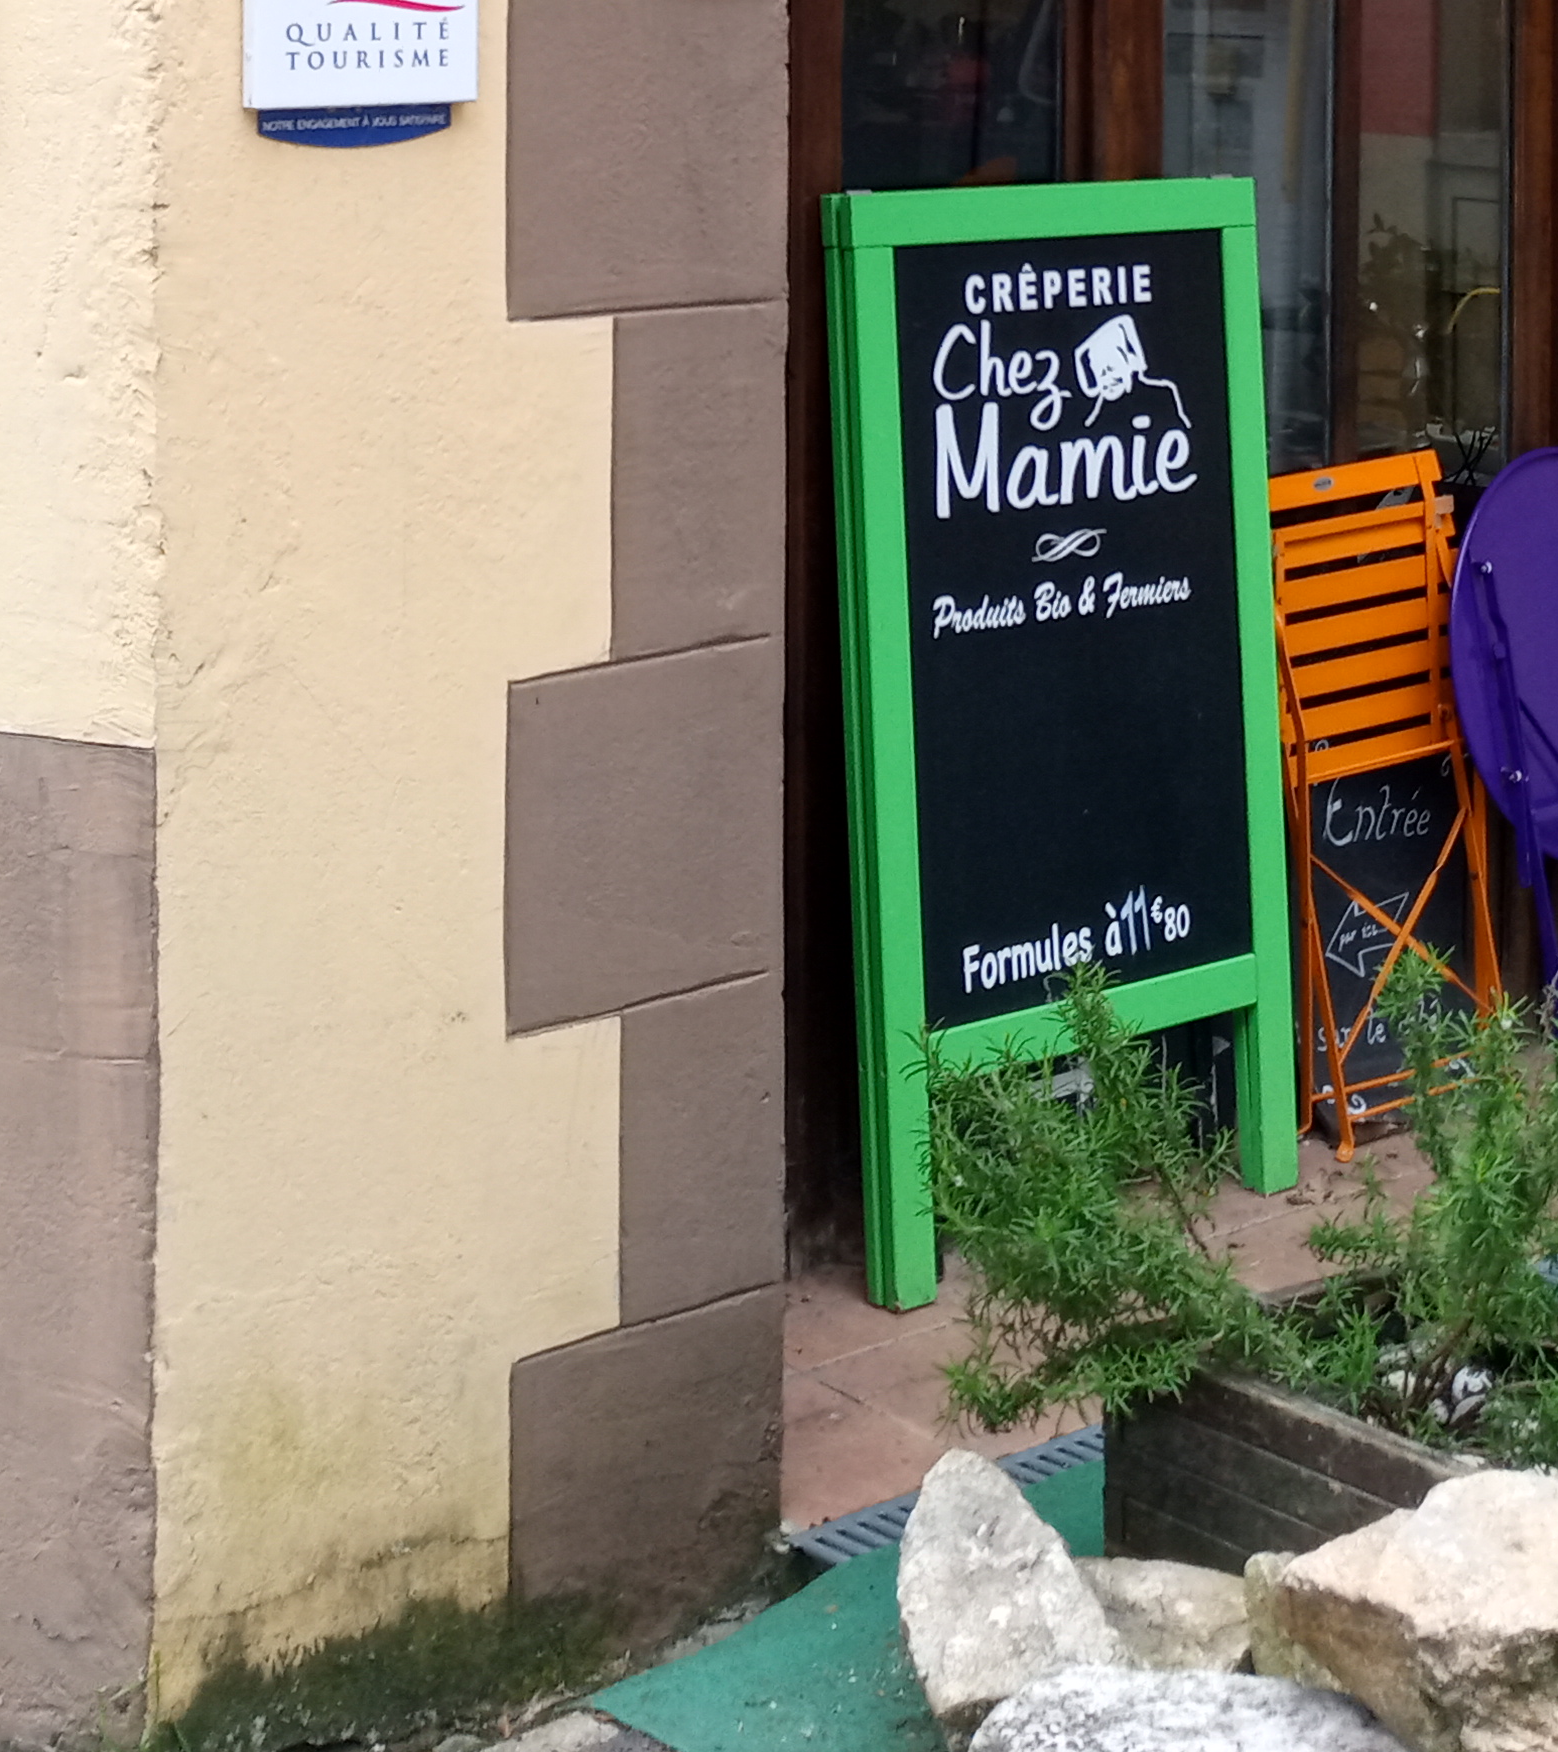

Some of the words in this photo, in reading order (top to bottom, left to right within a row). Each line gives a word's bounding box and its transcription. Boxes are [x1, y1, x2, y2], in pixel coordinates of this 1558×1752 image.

[285, 17, 449, 46] QUALITÉ
[285, 49, 449, 70] TOURISME
[965, 263, 1152, 314] CRÊPERIE
[933, 319, 1072, 430] Chez
[935, 402, 1197, 518] Mamie
[932, 594, 1026, 639] Produits
[1033, 581, 1071, 622] Bio
[1078, 576, 1095, 616] &
[1102, 572, 1191, 618] Fermiers
[1323, 784, 1431, 846] Entrée
[962, 922, 1094, 993] Formules
